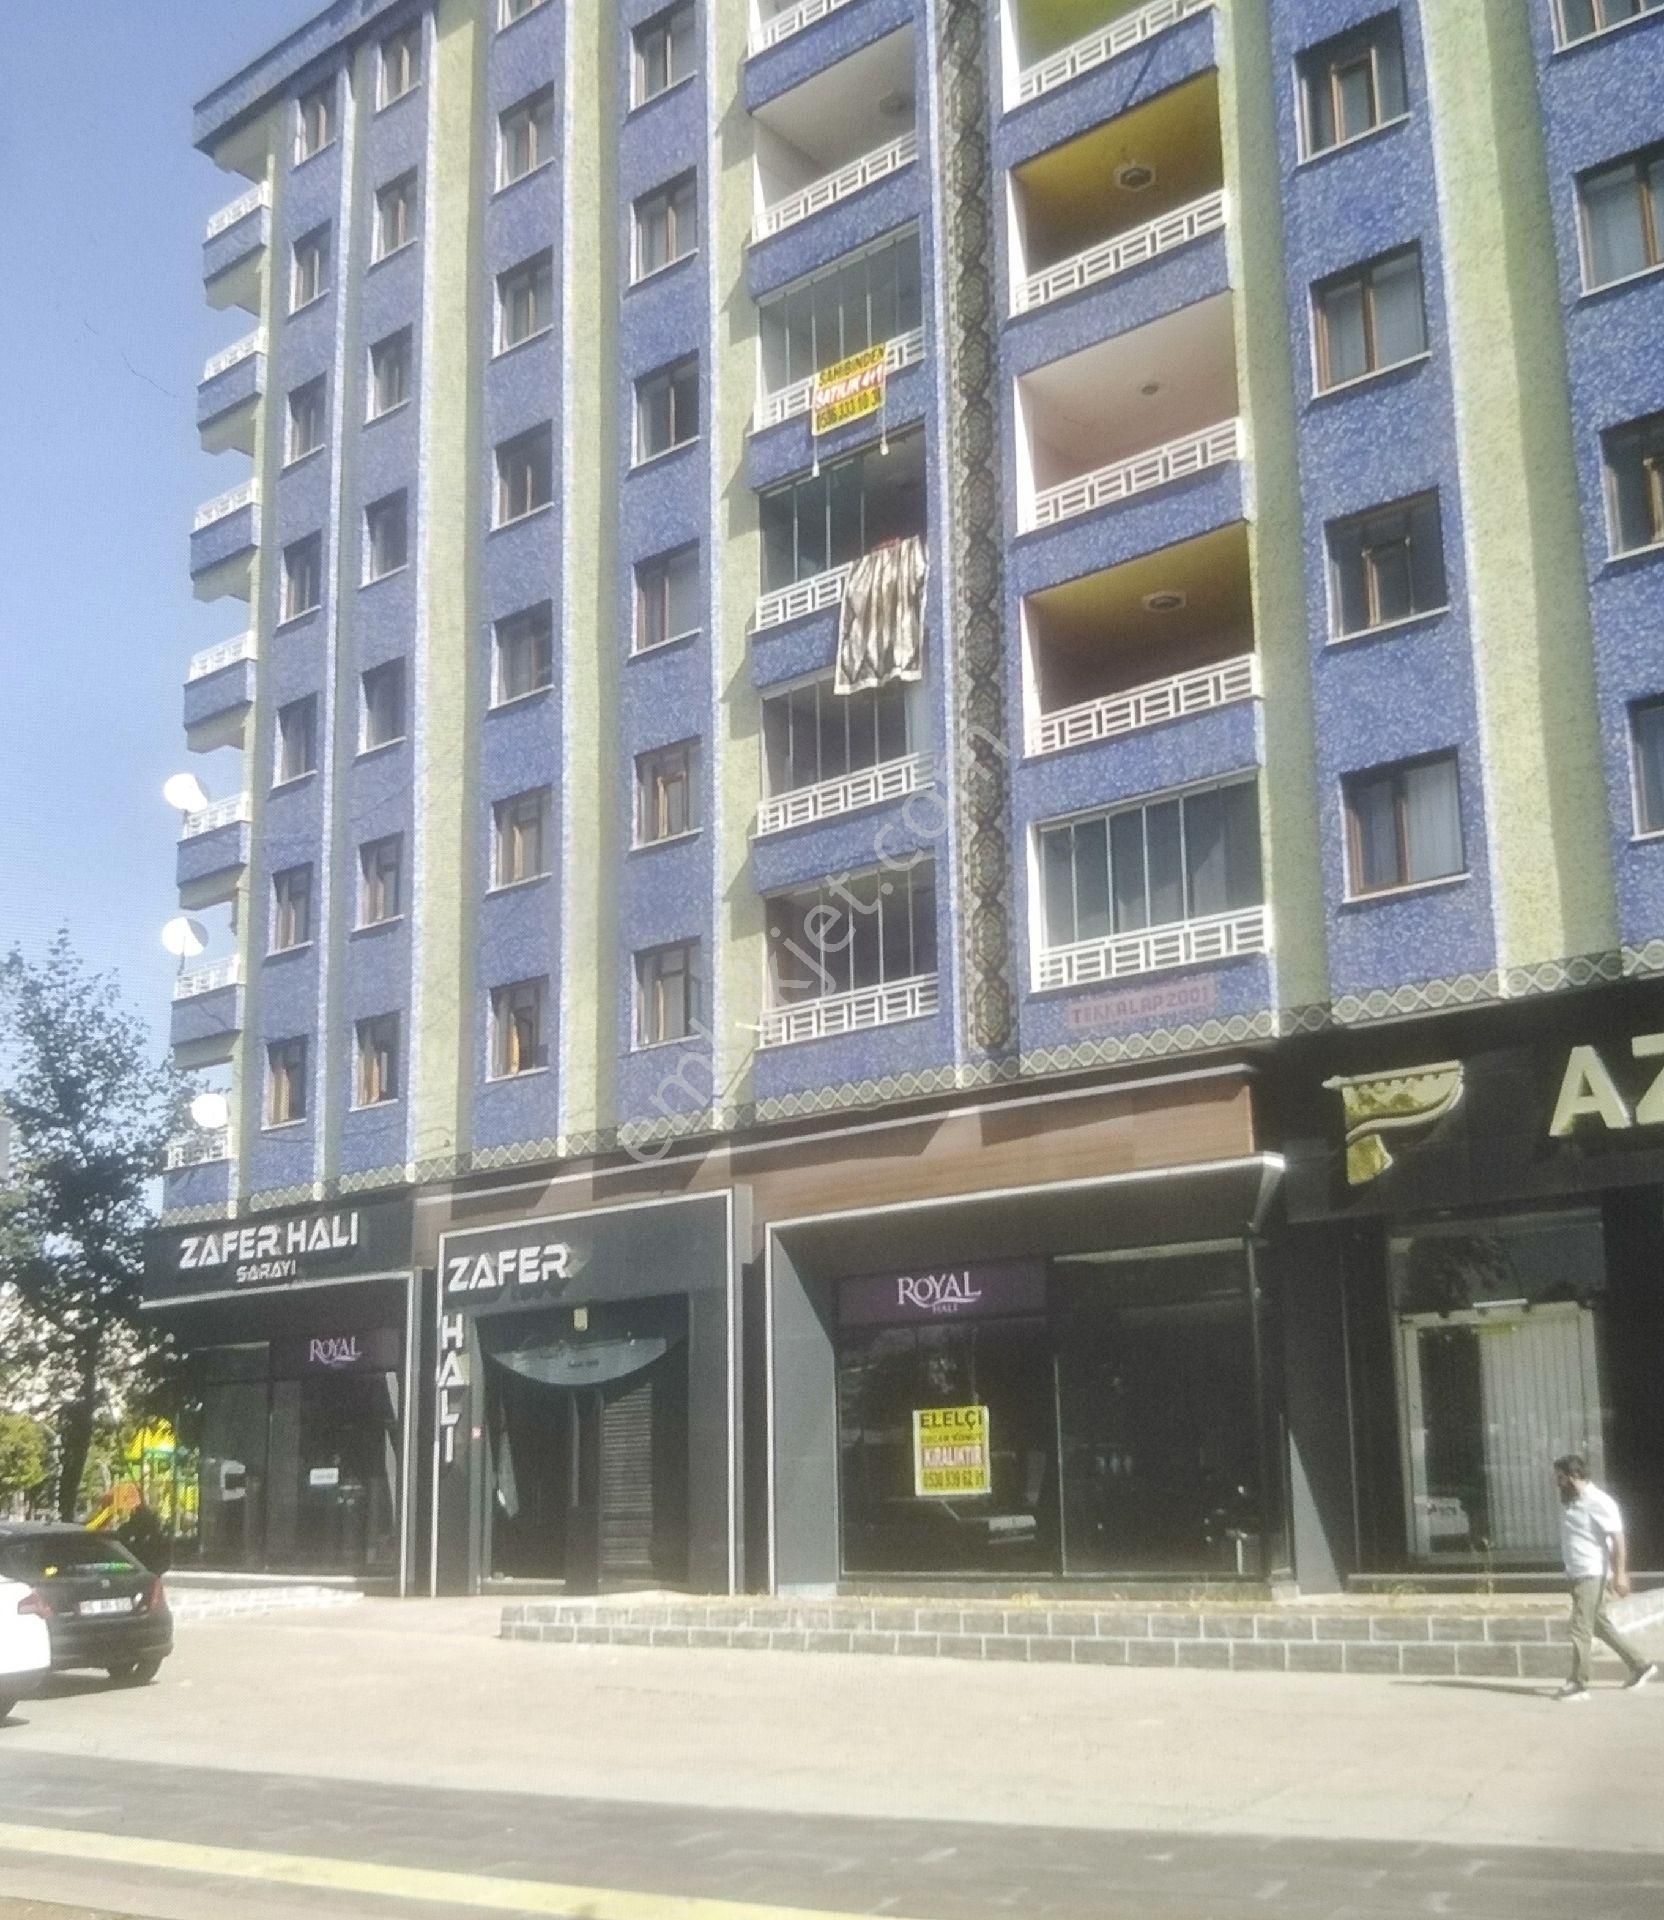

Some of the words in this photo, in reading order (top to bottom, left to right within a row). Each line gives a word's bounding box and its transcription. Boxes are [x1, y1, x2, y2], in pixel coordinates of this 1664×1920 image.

[179, 1224, 282, 1269] ZAFER
[287, 1211, 359, 1254] HALI
[236, 1259, 296, 1283] SARAYI
[448, 1242, 569, 1292] ZAFER
[897, 1270, 983, 1308] ROYAL
[309, 1336, 362, 1365] ROYAL
